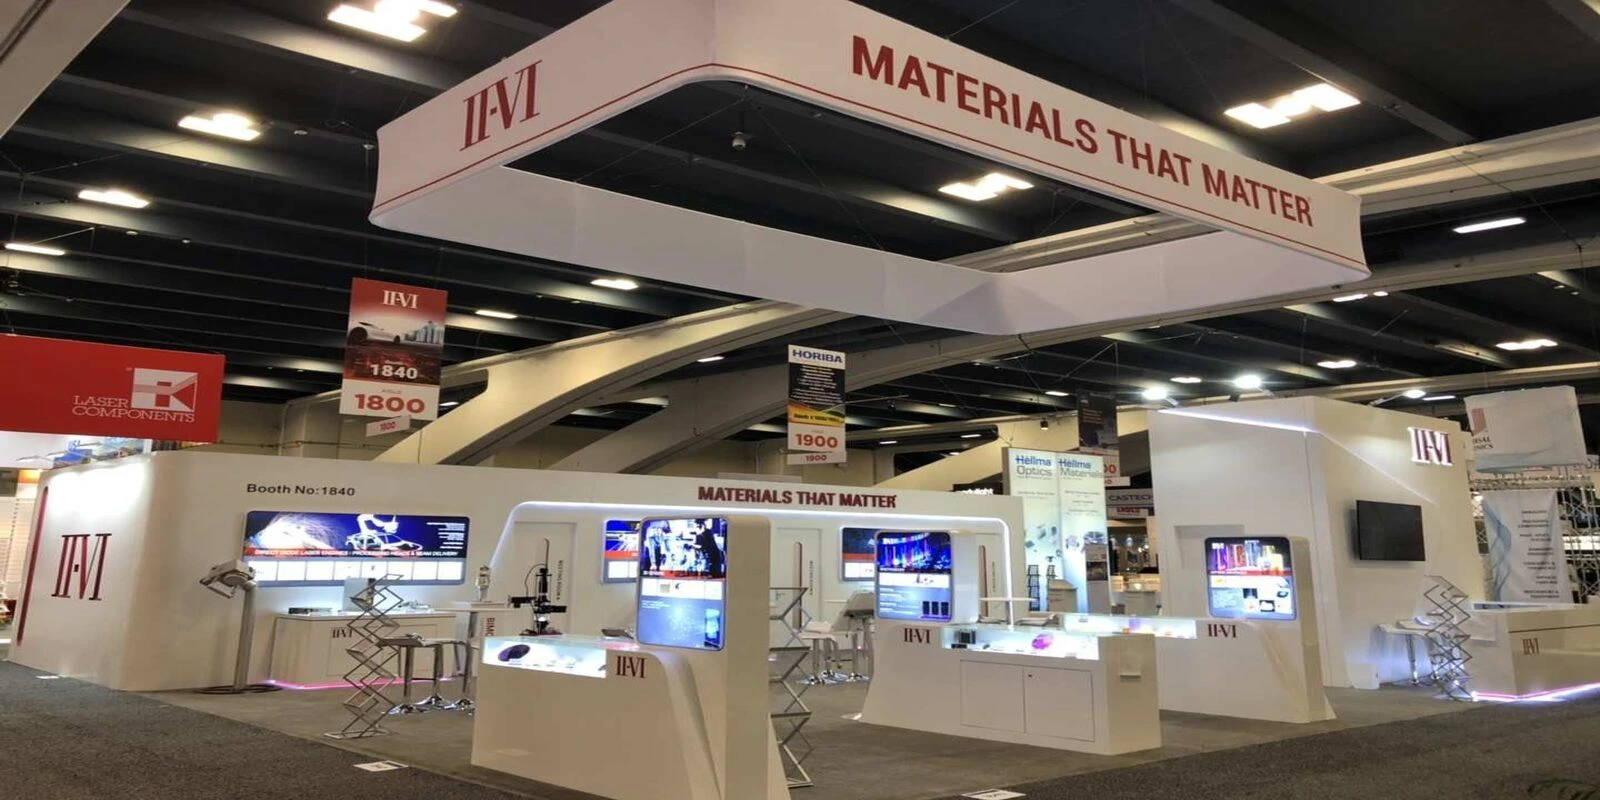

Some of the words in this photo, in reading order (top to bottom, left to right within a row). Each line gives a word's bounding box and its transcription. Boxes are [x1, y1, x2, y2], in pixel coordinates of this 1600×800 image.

[852, 35, 1098, 154] MATERIALS
[1107, 129, 1192, 186] THAT
[1201, 163, 1314, 227] MATTER
[792, 349, 843, 363] HORIBA
[370, 364, 418, 380] 1840
[73, 395, 130, 409] LASER
[355, 393, 425, 414] 1800
[72, 405, 195, 423] COMPONENTS
[795, 433, 838, 448] 1900
[805, 454, 828, 462] 1900
[1015, 455, 1052, 467] Hellma
[1058, 457, 1092, 469] Hellma
[1016, 465, 1053, 479] Optics
[1060, 467, 1104, 479] Materials
[246, 483, 291, 495] Booth
[698, 486, 793, 504] MATERIALS
[796, 490, 836, 506] THAT
[839, 493, 897, 509] MATTER
